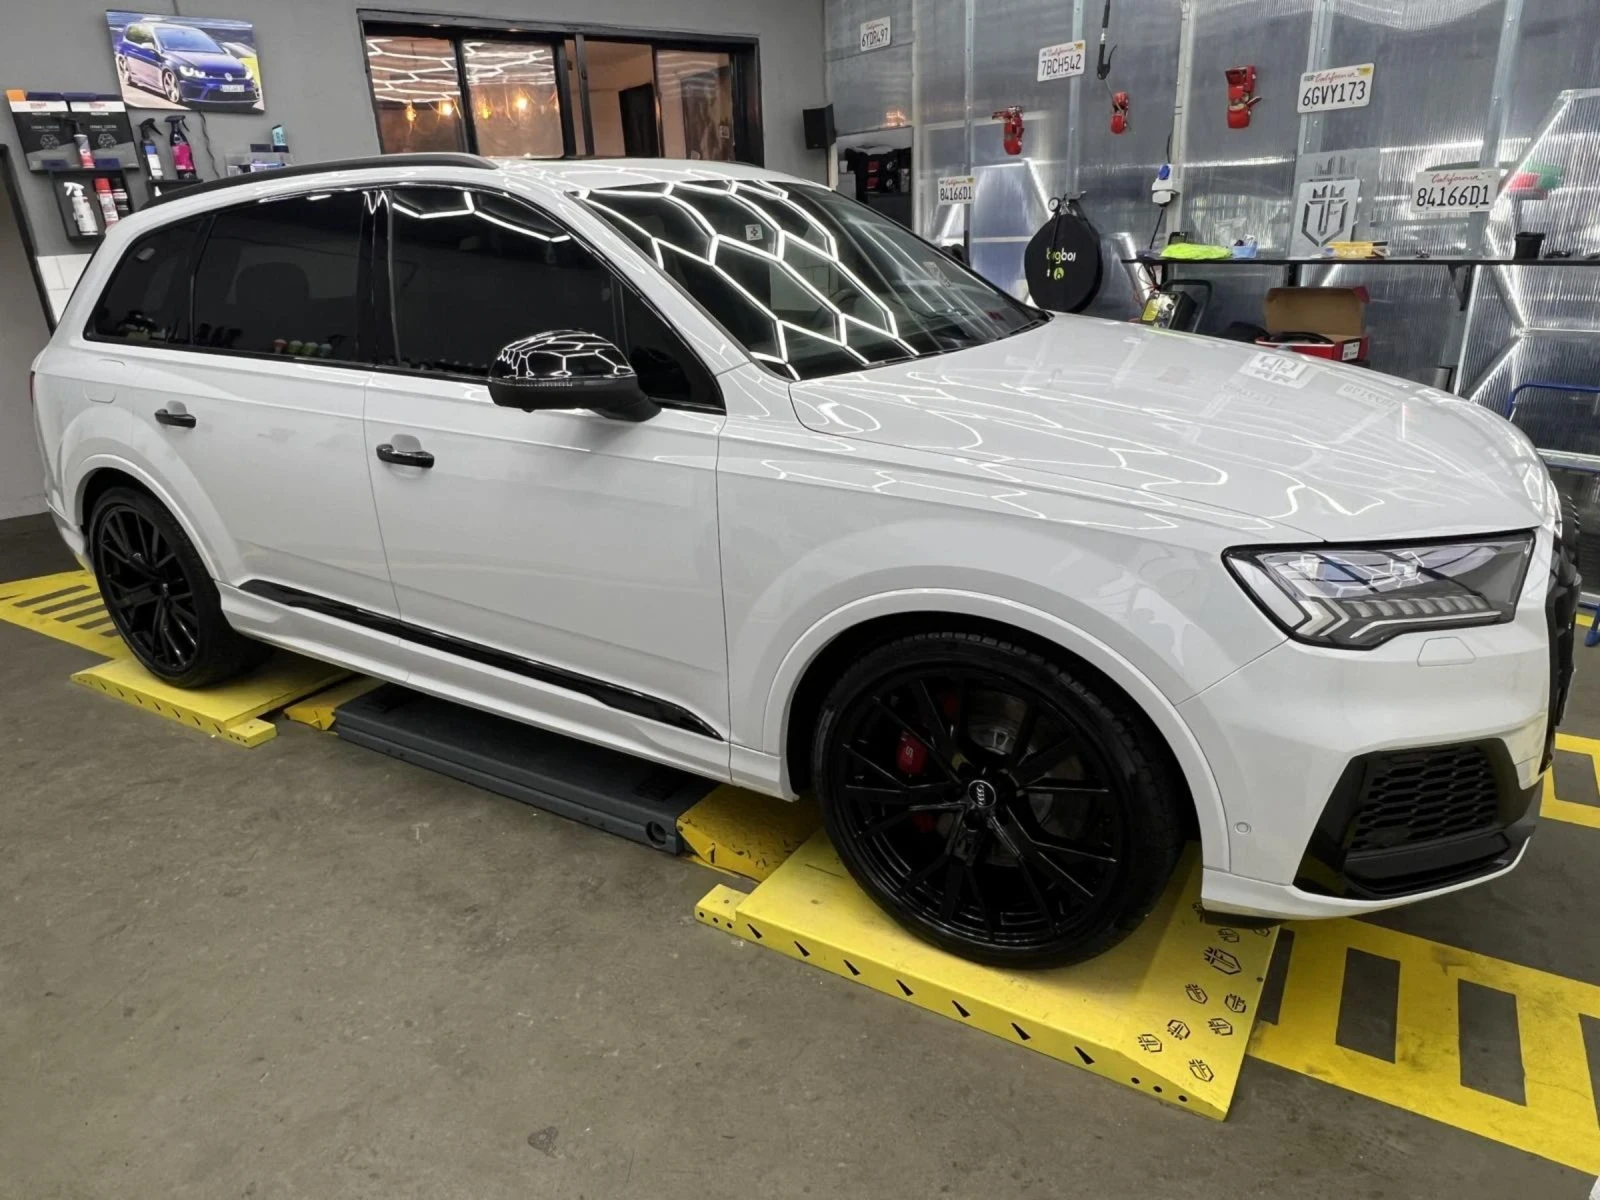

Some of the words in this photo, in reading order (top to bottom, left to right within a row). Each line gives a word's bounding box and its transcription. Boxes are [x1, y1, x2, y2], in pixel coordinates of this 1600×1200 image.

[1041, 53, 1082, 76] 7BCH542
[1302, 80, 1366, 106] 6GVY173
[1431, 172, 1482, 185] California
[940, 186, 972, 201] 84166D1
[1416, 184, 1489, 207] 84166D1
